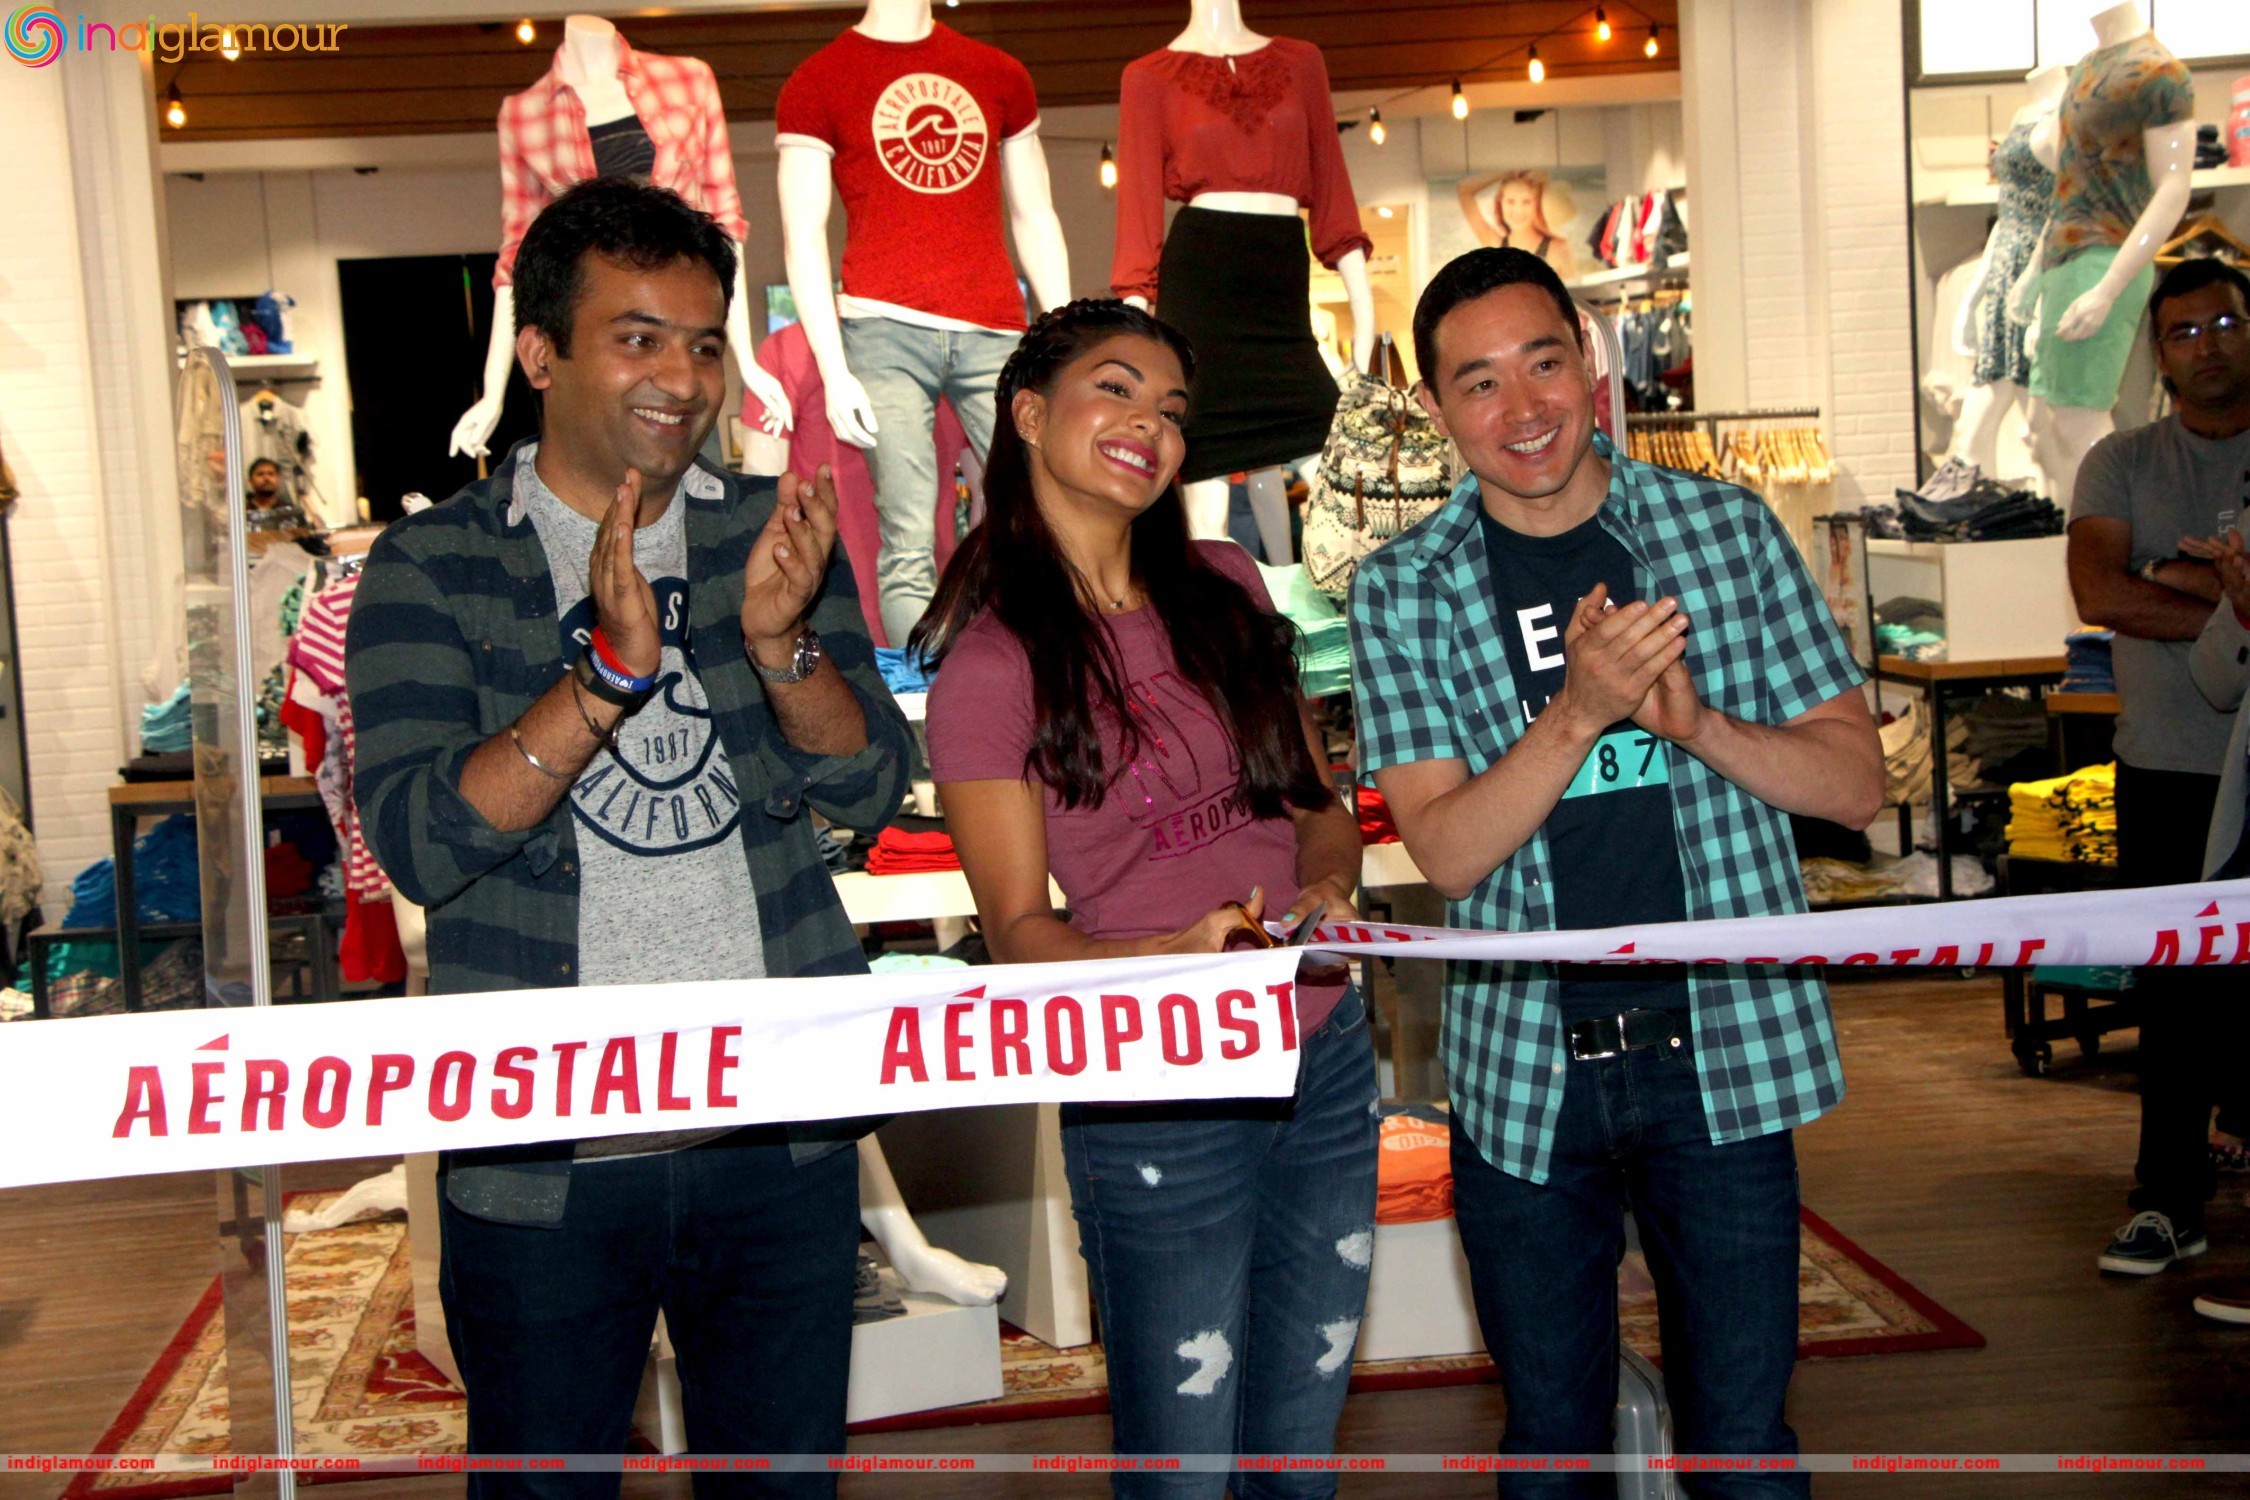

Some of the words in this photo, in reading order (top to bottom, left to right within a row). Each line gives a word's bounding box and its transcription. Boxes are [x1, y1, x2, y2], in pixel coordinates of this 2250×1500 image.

[878, 79, 980, 132] AEROPOSTALE
[885, 140, 983, 188] CALIFORNIA
[643, 728, 689, 765] 1987
[573, 753, 739, 841] ALIFORN
[1152, 796, 1250, 852] AEROPO
[112, 1026, 743, 1139] AÉROPOSTALE
[881, 982, 1297, 1085] AÉROPOST
